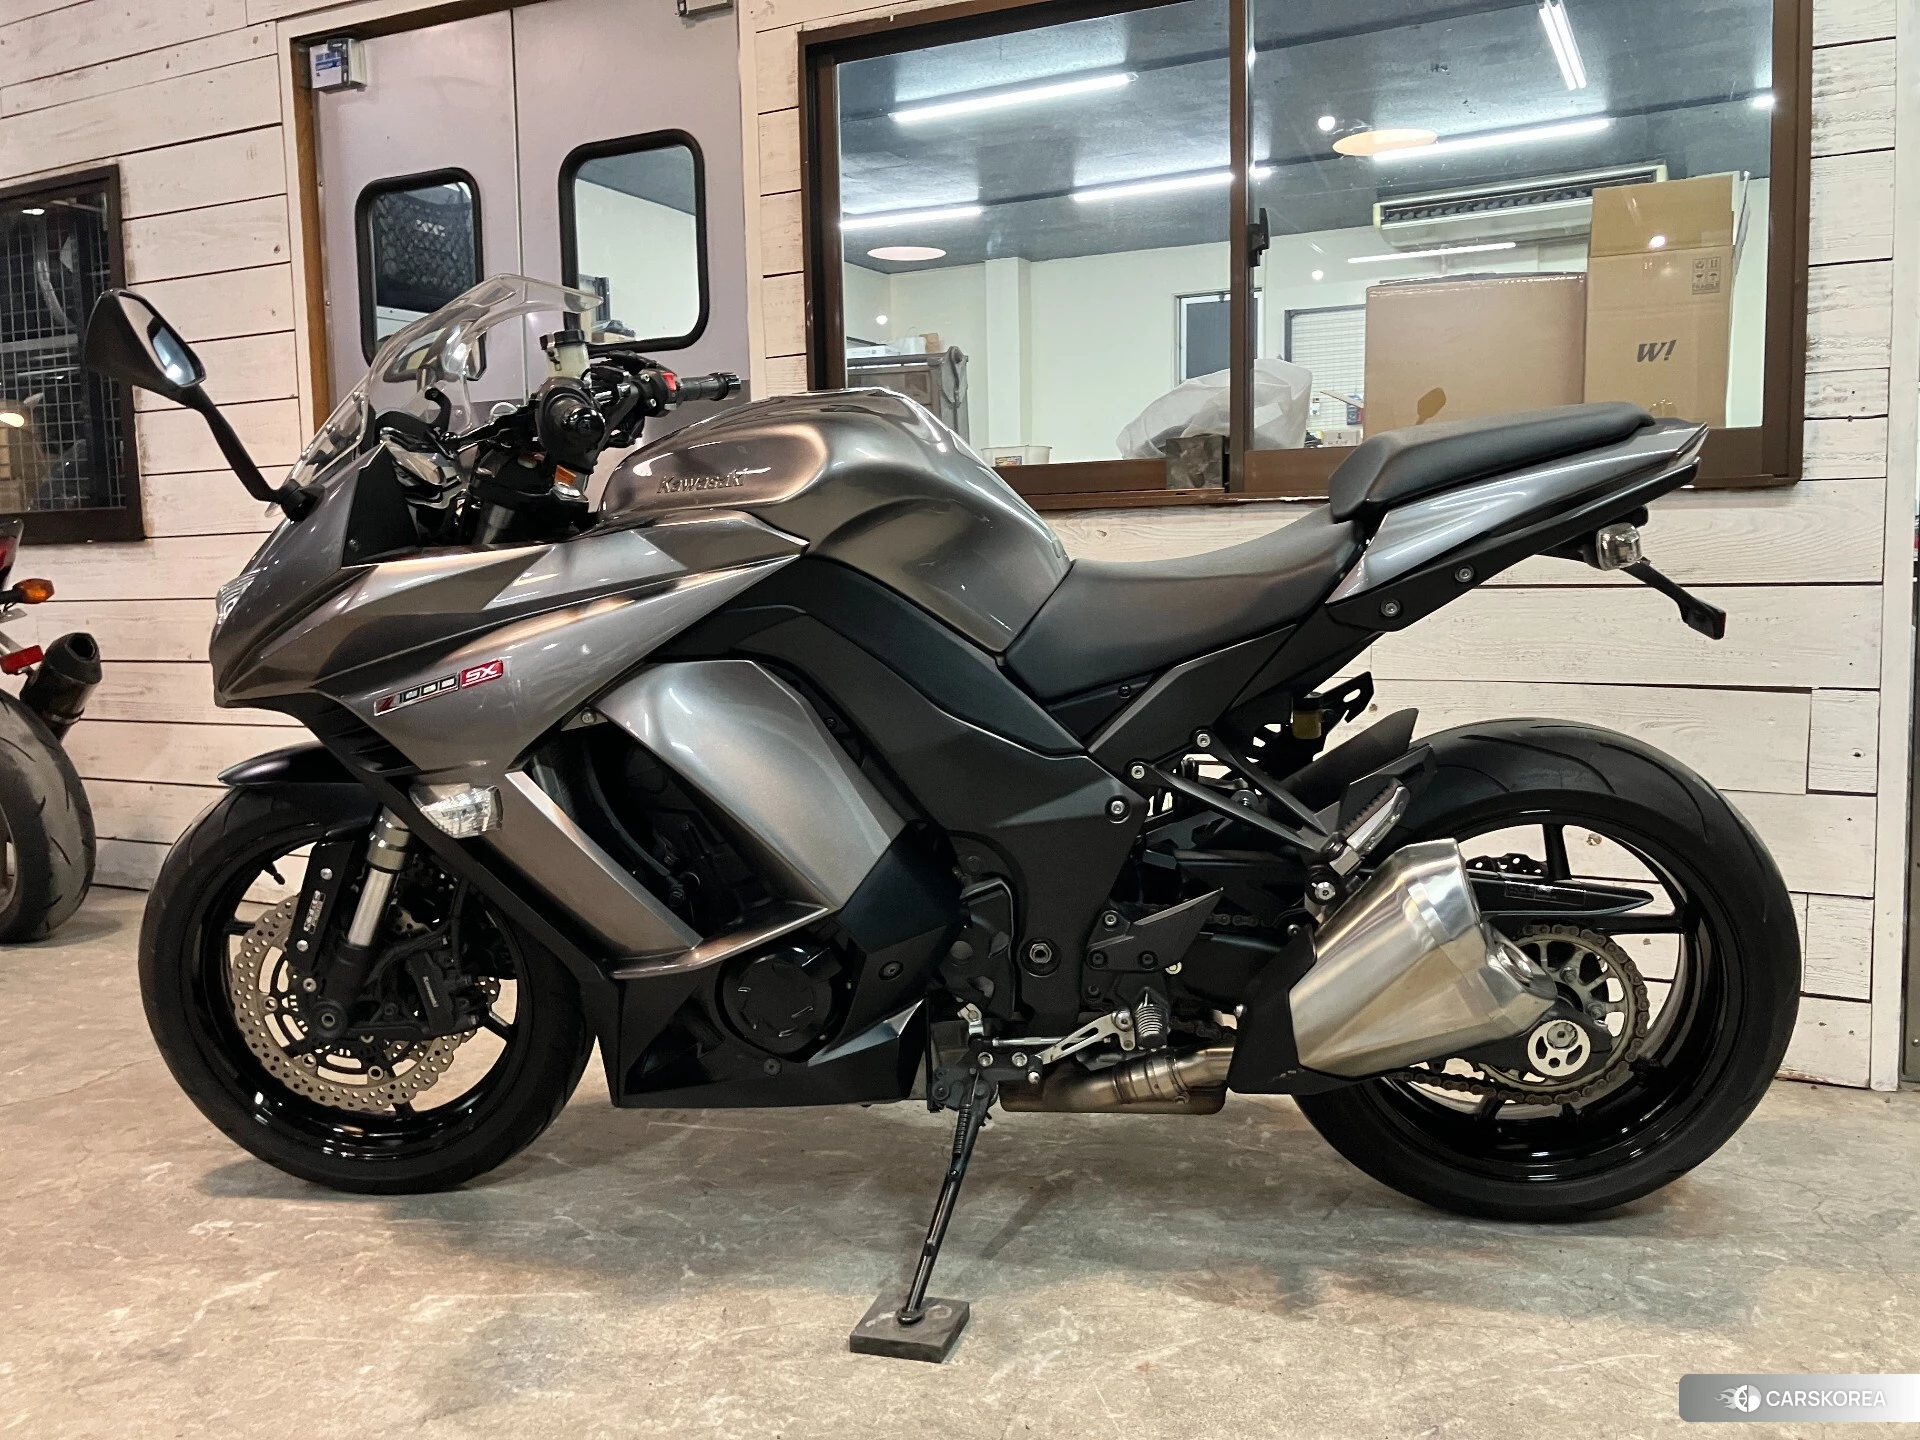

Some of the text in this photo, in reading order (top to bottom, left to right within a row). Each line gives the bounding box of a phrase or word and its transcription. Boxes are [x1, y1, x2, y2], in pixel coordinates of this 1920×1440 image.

[1637, 340, 1677, 362] W!
[376, 664, 498, 712] Z1000 SX
